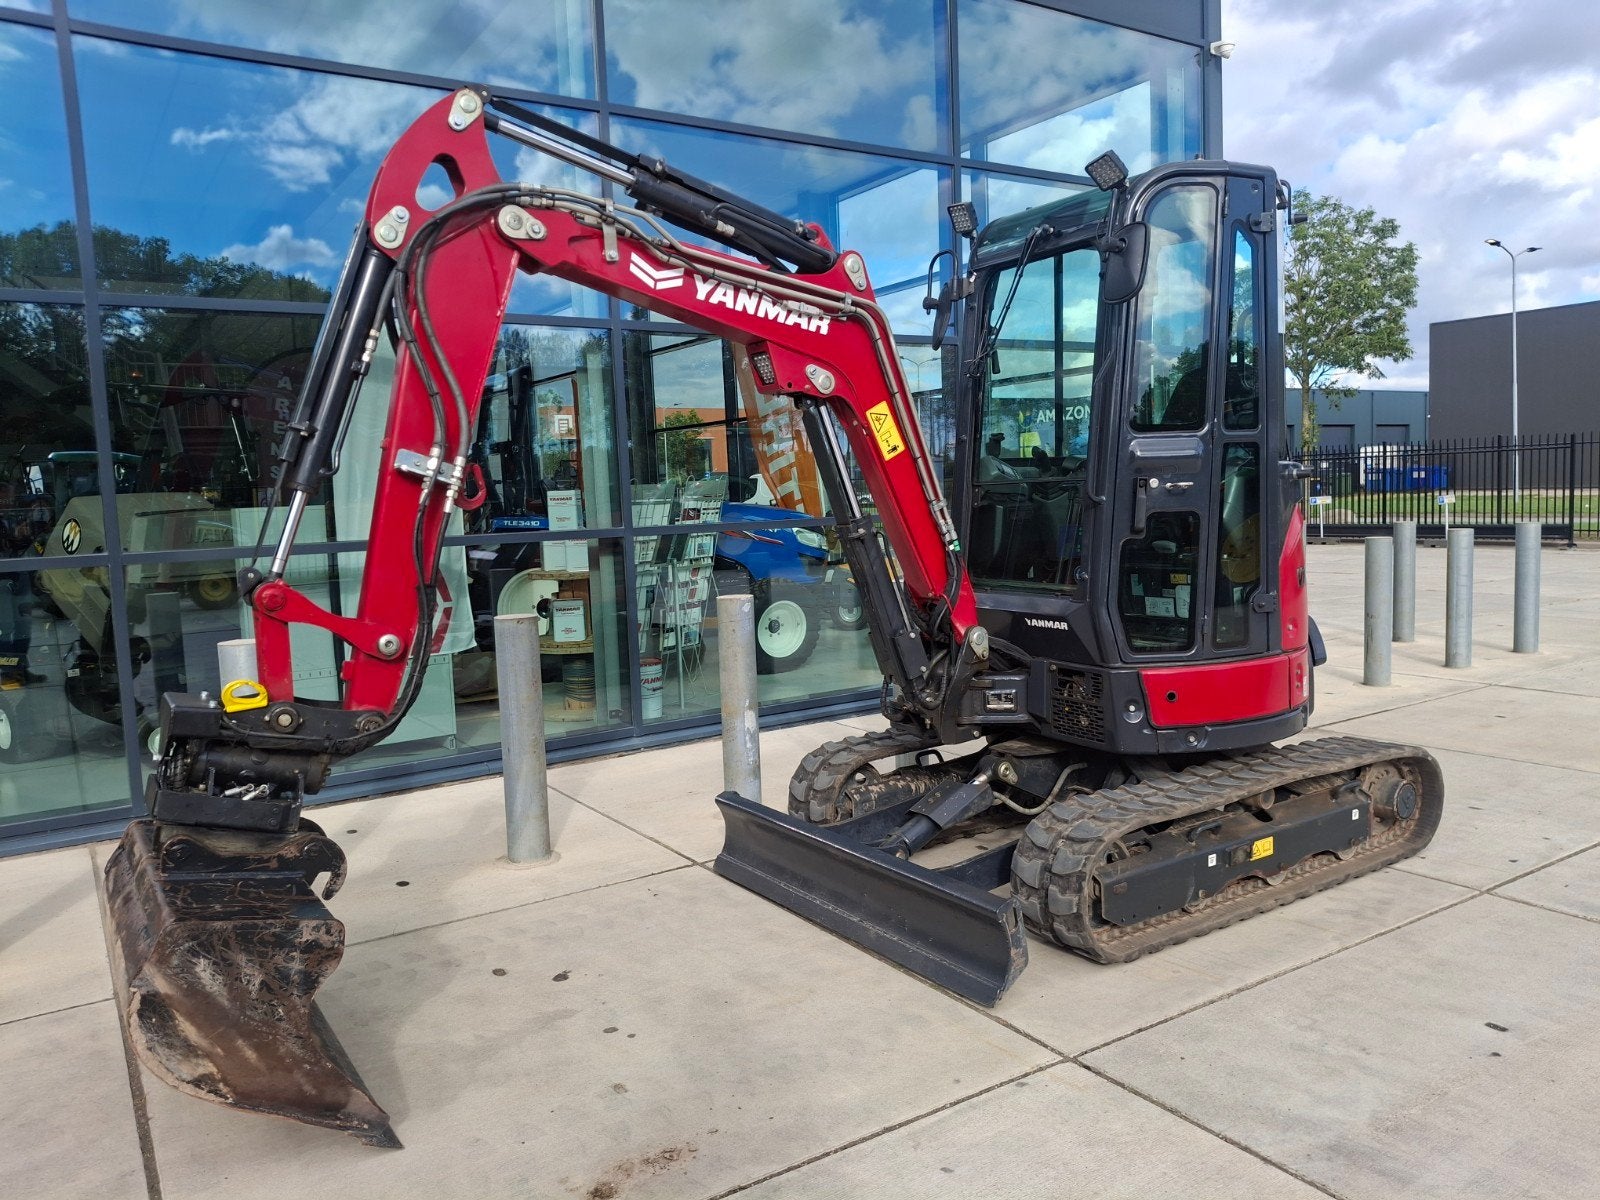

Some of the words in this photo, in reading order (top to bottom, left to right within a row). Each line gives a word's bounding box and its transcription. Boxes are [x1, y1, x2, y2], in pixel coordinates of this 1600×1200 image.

[693, 273, 830, 336] YANMAR
[1036, 405, 1091, 423] AMZON
[1024, 617, 1069, 631] YANMAR
